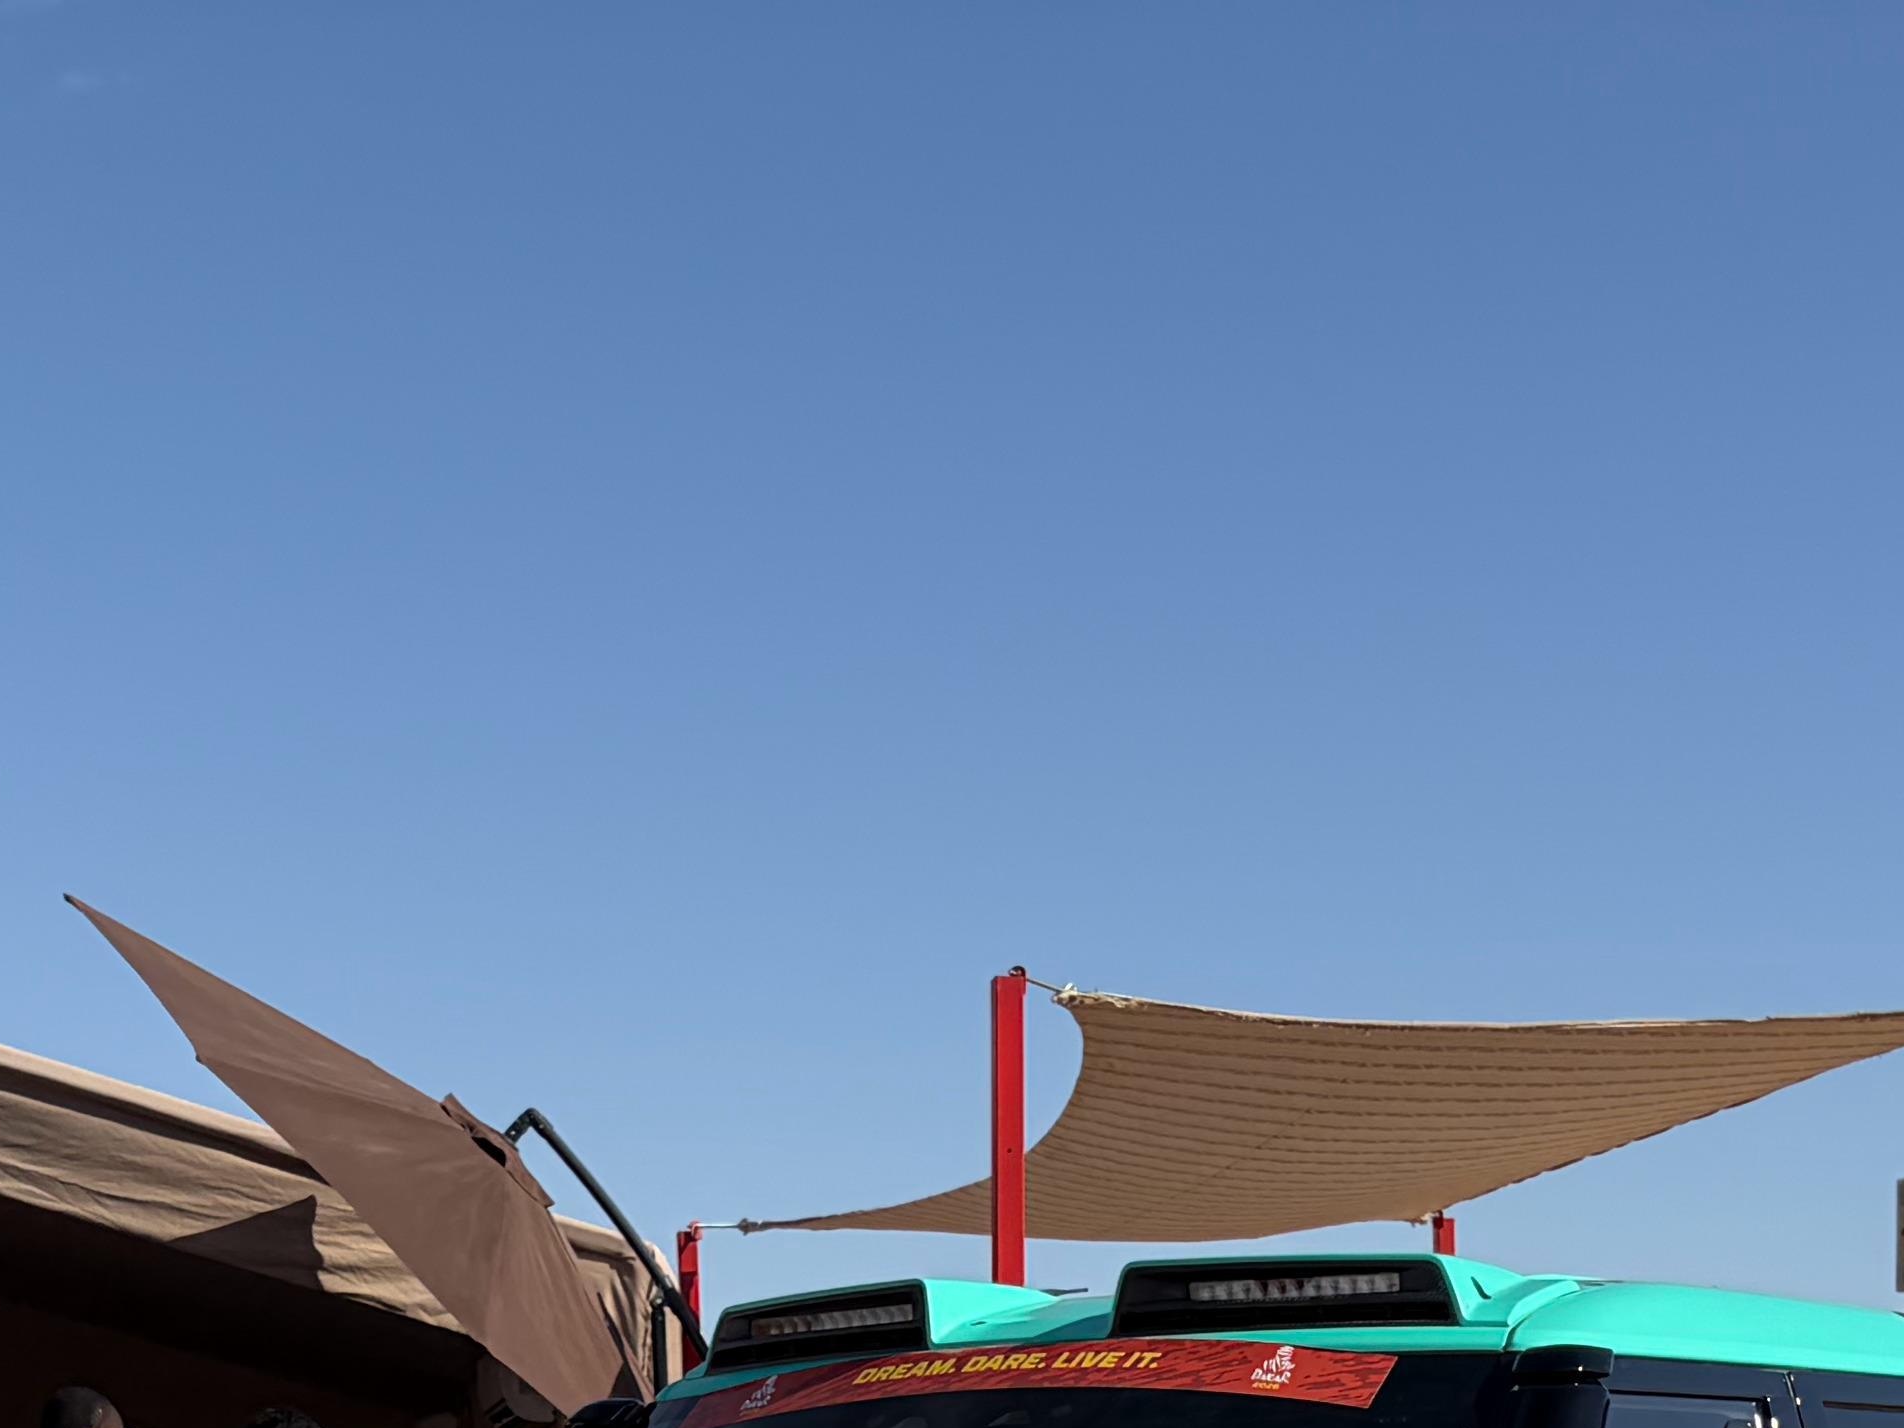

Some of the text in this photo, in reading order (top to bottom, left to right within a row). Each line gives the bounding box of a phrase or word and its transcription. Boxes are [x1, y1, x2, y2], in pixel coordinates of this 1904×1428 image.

[853, 1352, 1163, 1385] DREAM. DARE. LIVE IT.
